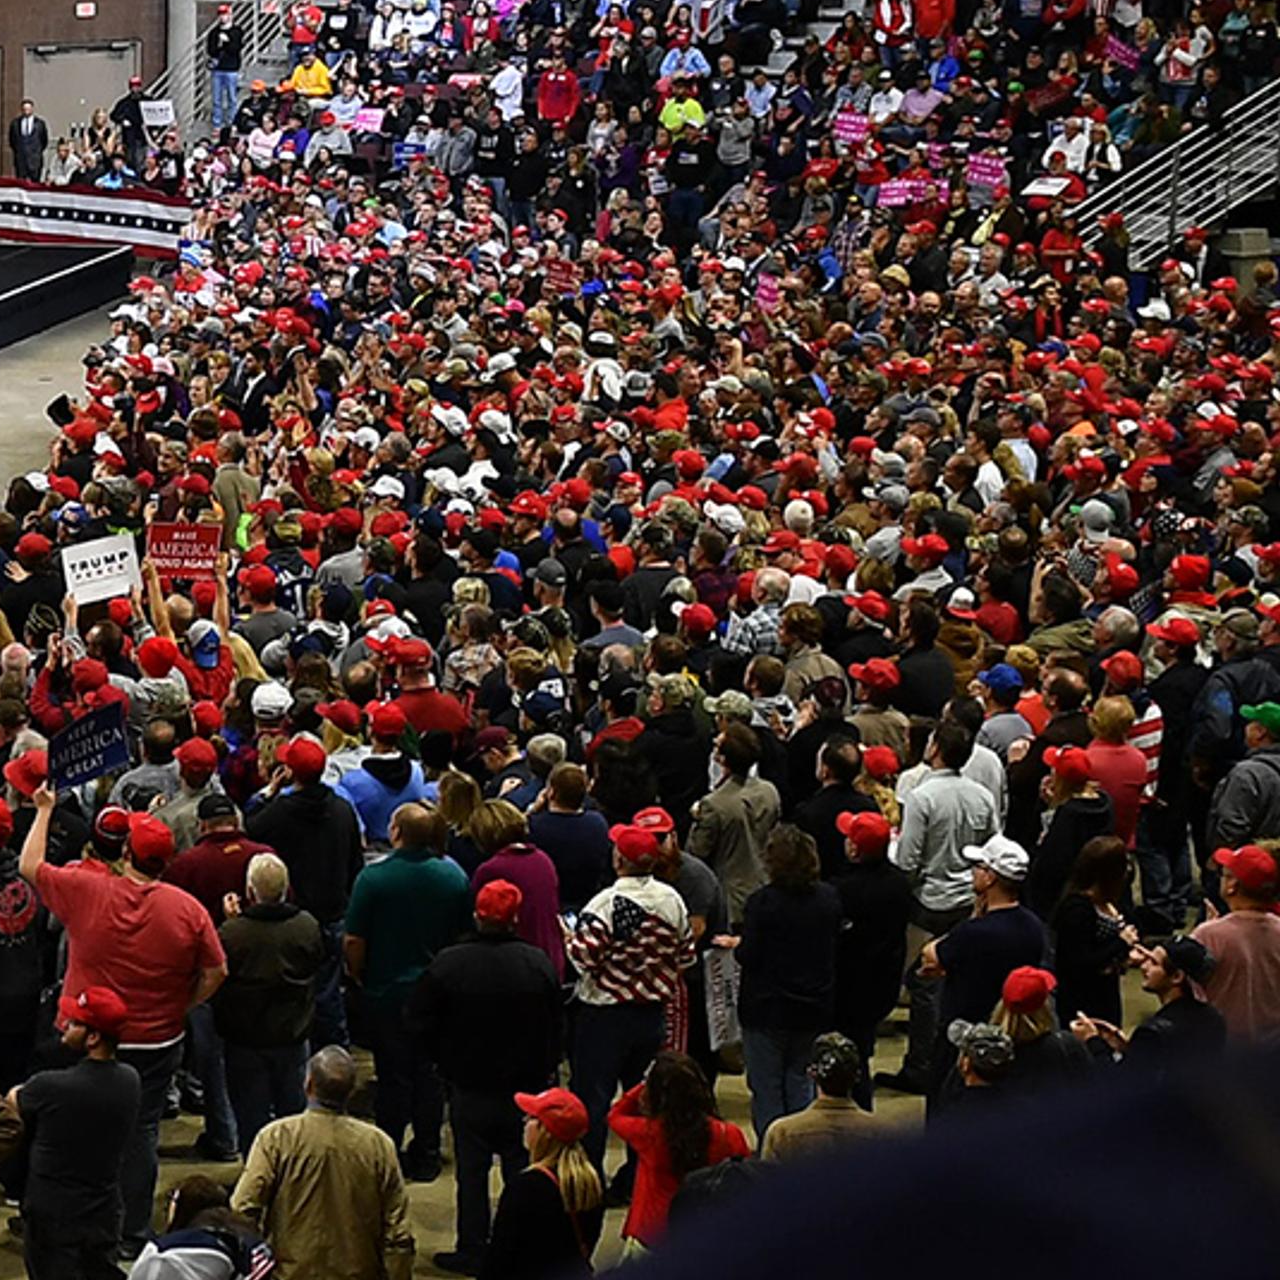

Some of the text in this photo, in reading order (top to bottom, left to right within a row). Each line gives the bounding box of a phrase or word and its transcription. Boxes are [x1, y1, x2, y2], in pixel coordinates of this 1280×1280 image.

[151, 541, 218, 557] AMERICA
[70, 551, 128, 573] TRUMP
[151, 558, 182, 569] ROUD
[51, 727, 123, 768] MERICA
